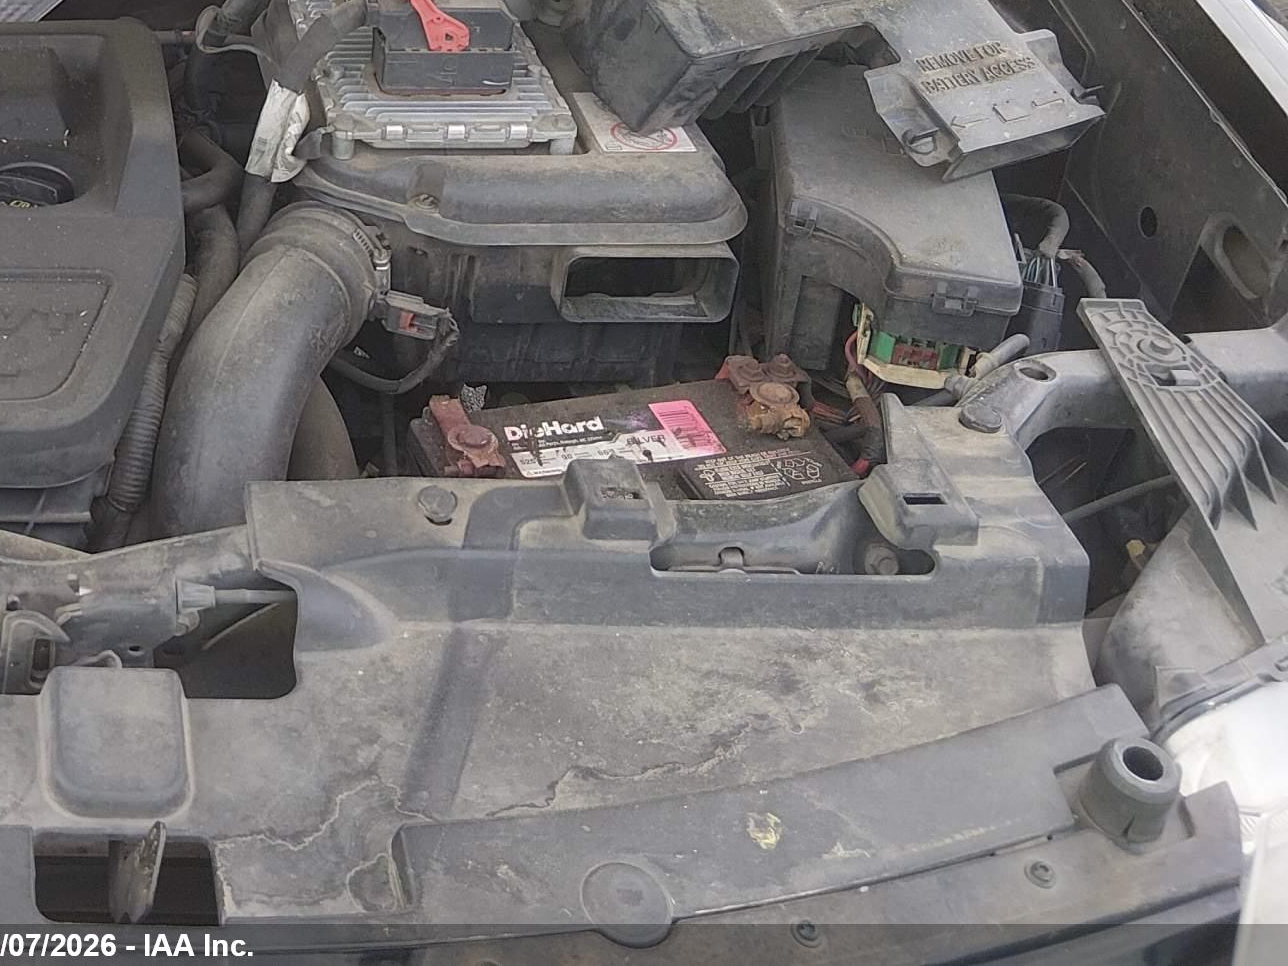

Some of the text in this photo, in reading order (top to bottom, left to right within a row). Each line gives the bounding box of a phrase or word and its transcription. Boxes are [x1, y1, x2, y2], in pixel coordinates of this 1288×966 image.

[915, 41, 1006, 73] REMOVE FOR
[920, 56, 1036, 94] BATTERY ACCESS
[503, 415, 605, 442] DieHard
